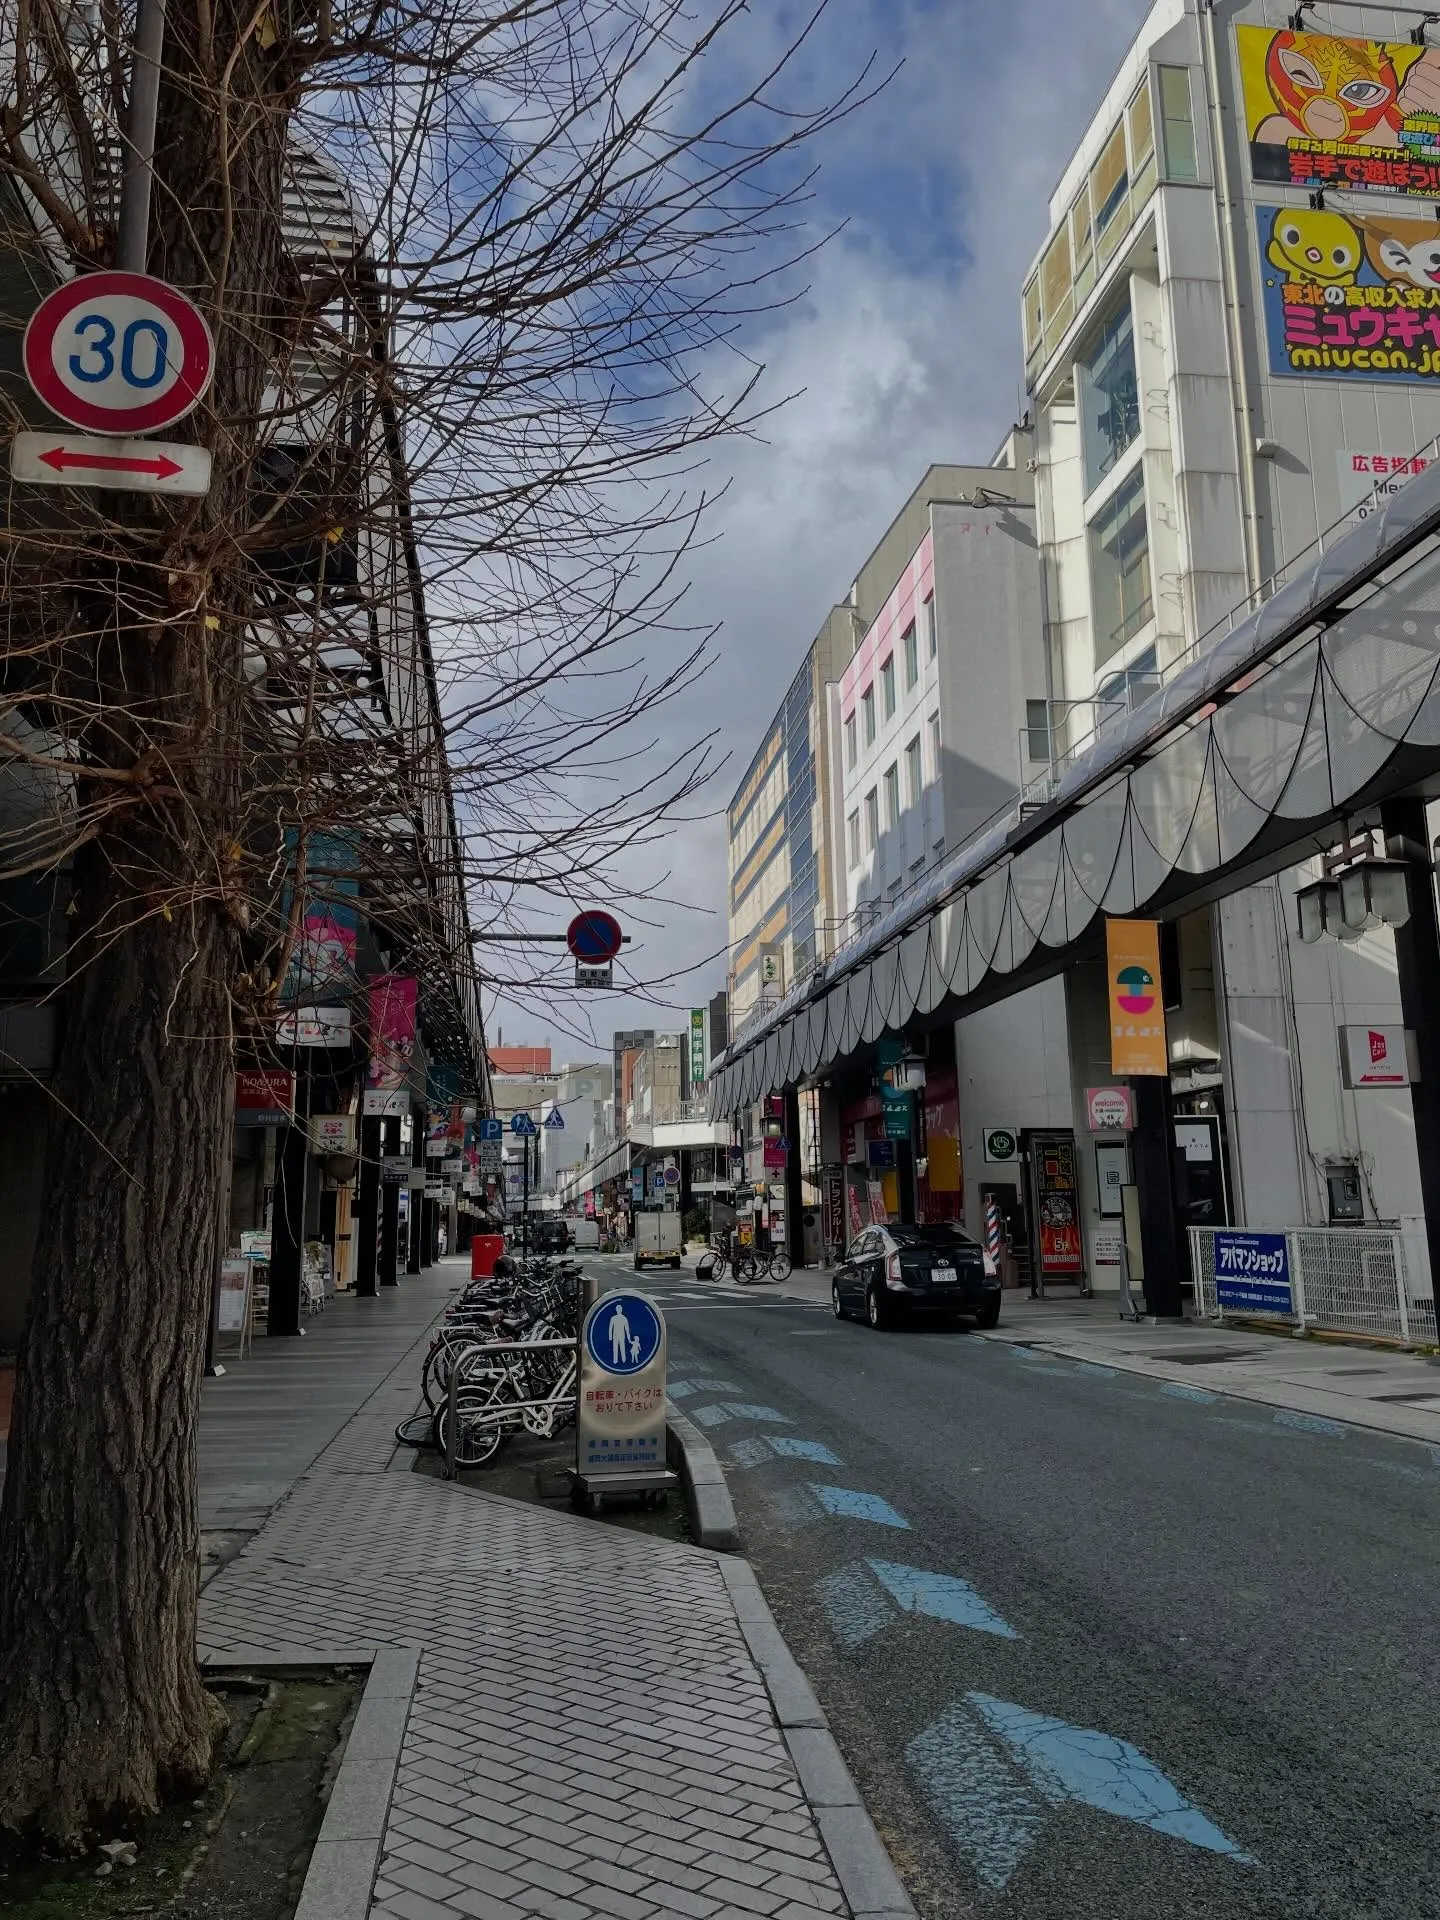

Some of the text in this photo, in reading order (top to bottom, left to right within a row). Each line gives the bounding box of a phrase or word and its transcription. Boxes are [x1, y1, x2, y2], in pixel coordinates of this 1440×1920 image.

[69, 314, 168, 388] 30
[486, 1122, 498, 1138] P
[656, 1177, 664, 1187] P
[831, 1180, 843, 1245] トランクルーム
[1220, 1246, 1284, 1273] アパマンショップ
[586, 1388, 662, 1401] 自転車・バイクは
[595, 1401, 653, 1413] おりて下さい
